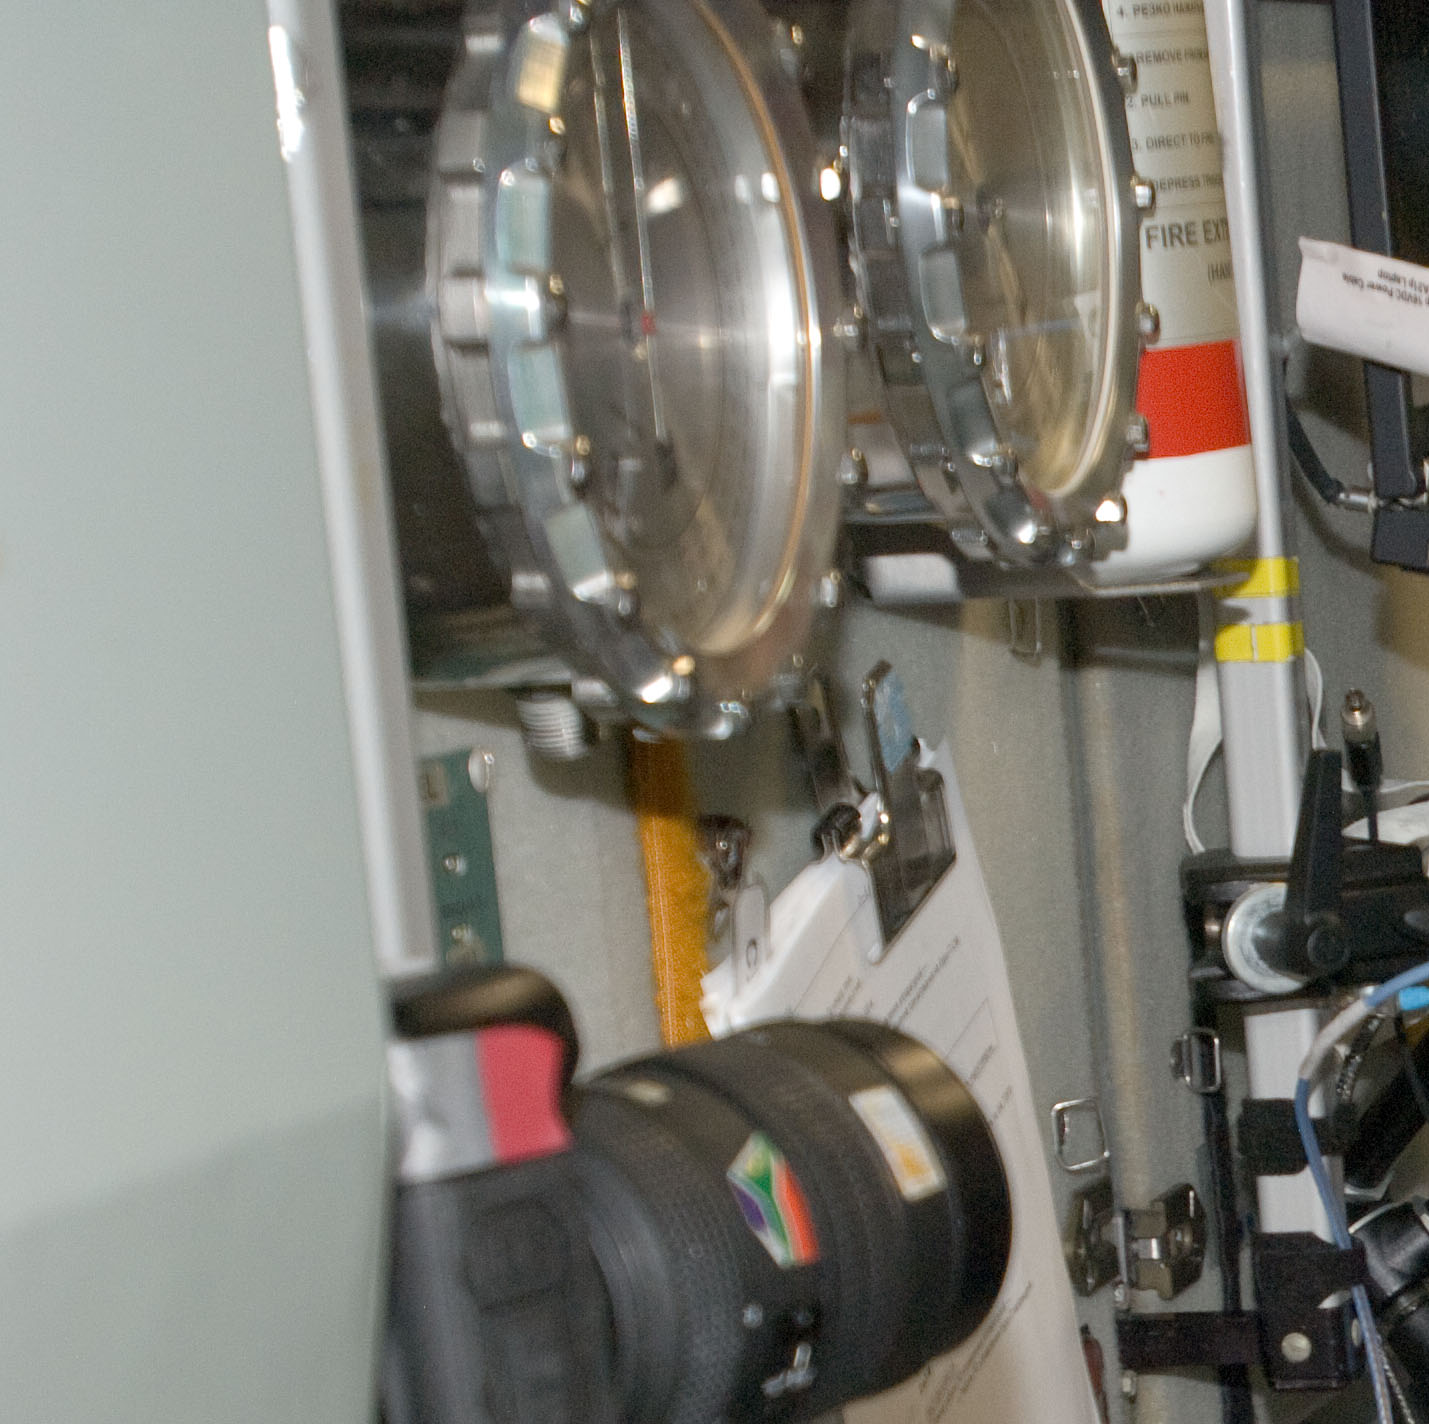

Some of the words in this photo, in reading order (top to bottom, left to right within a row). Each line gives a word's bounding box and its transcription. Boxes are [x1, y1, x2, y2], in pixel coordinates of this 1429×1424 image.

[1141, 92, 1172, 108] PULL
[1146, 133, 1187, 150] DIRECT
[1145, 221, 1199, 249] FIRE
